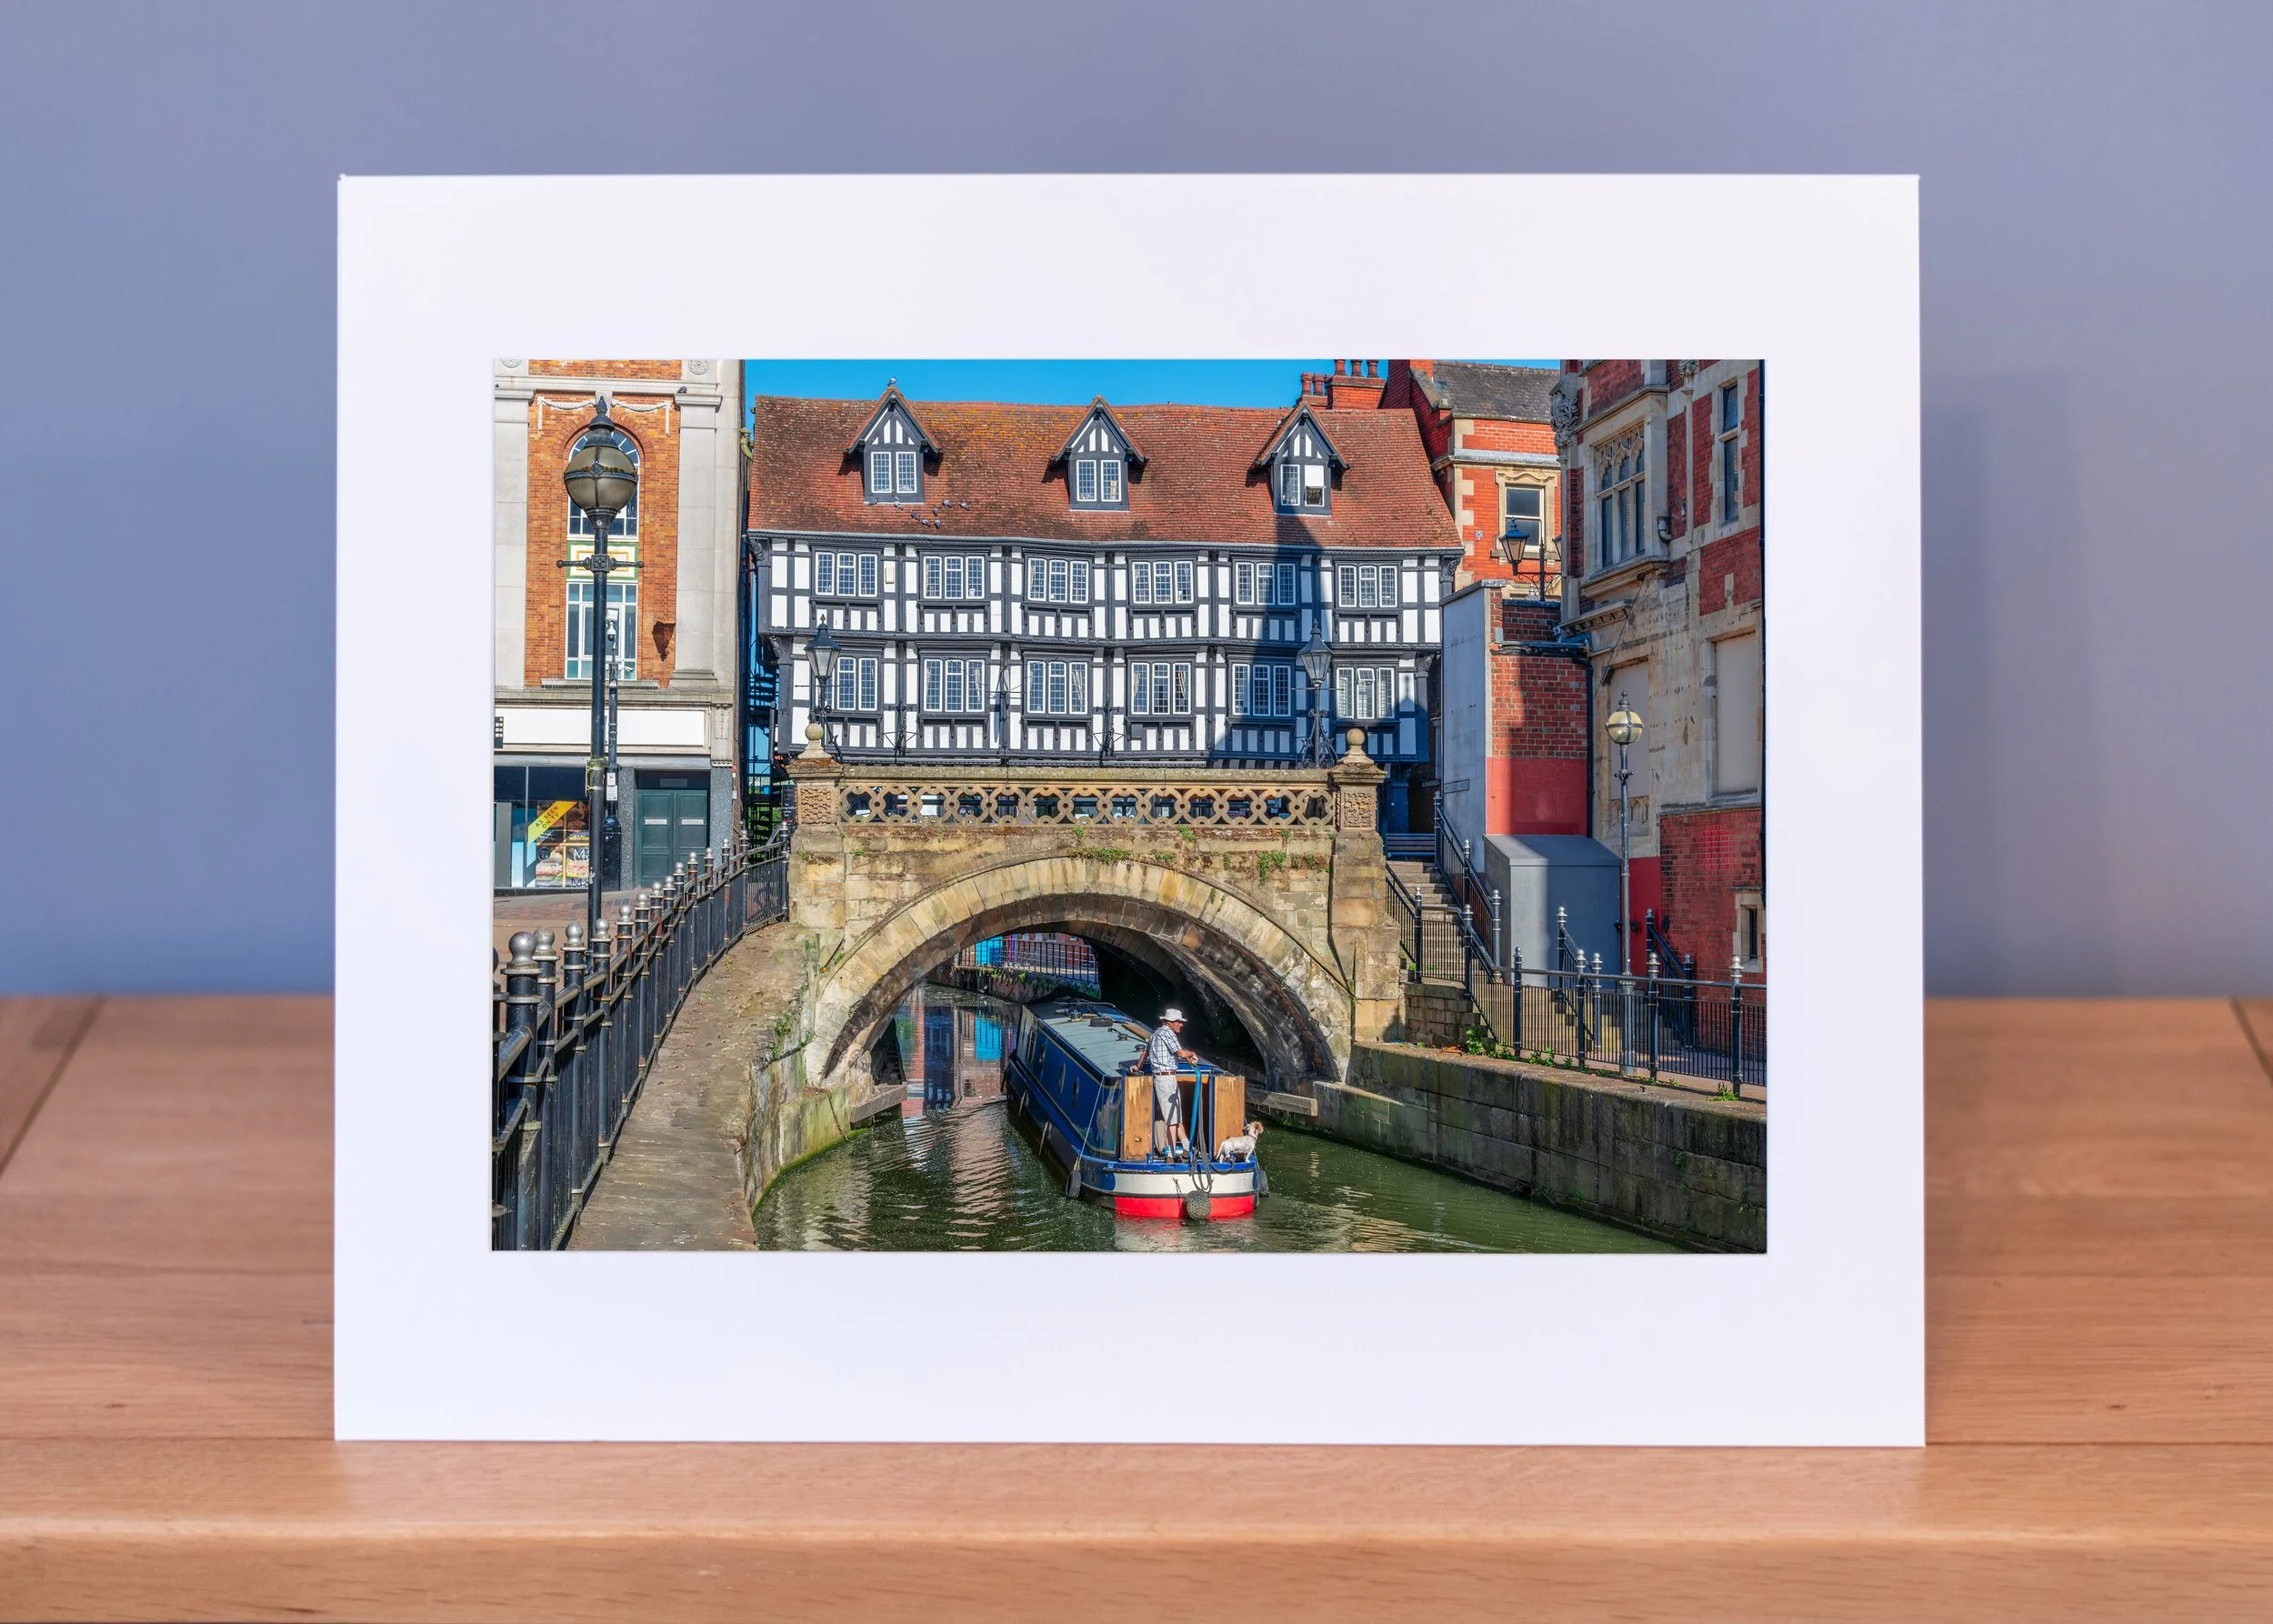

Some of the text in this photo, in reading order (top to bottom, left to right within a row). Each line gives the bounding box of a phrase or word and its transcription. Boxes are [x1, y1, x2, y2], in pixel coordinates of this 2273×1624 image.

[536, 806, 559, 827] AS SEEN
[542, 812, 559, 828] ON TV
